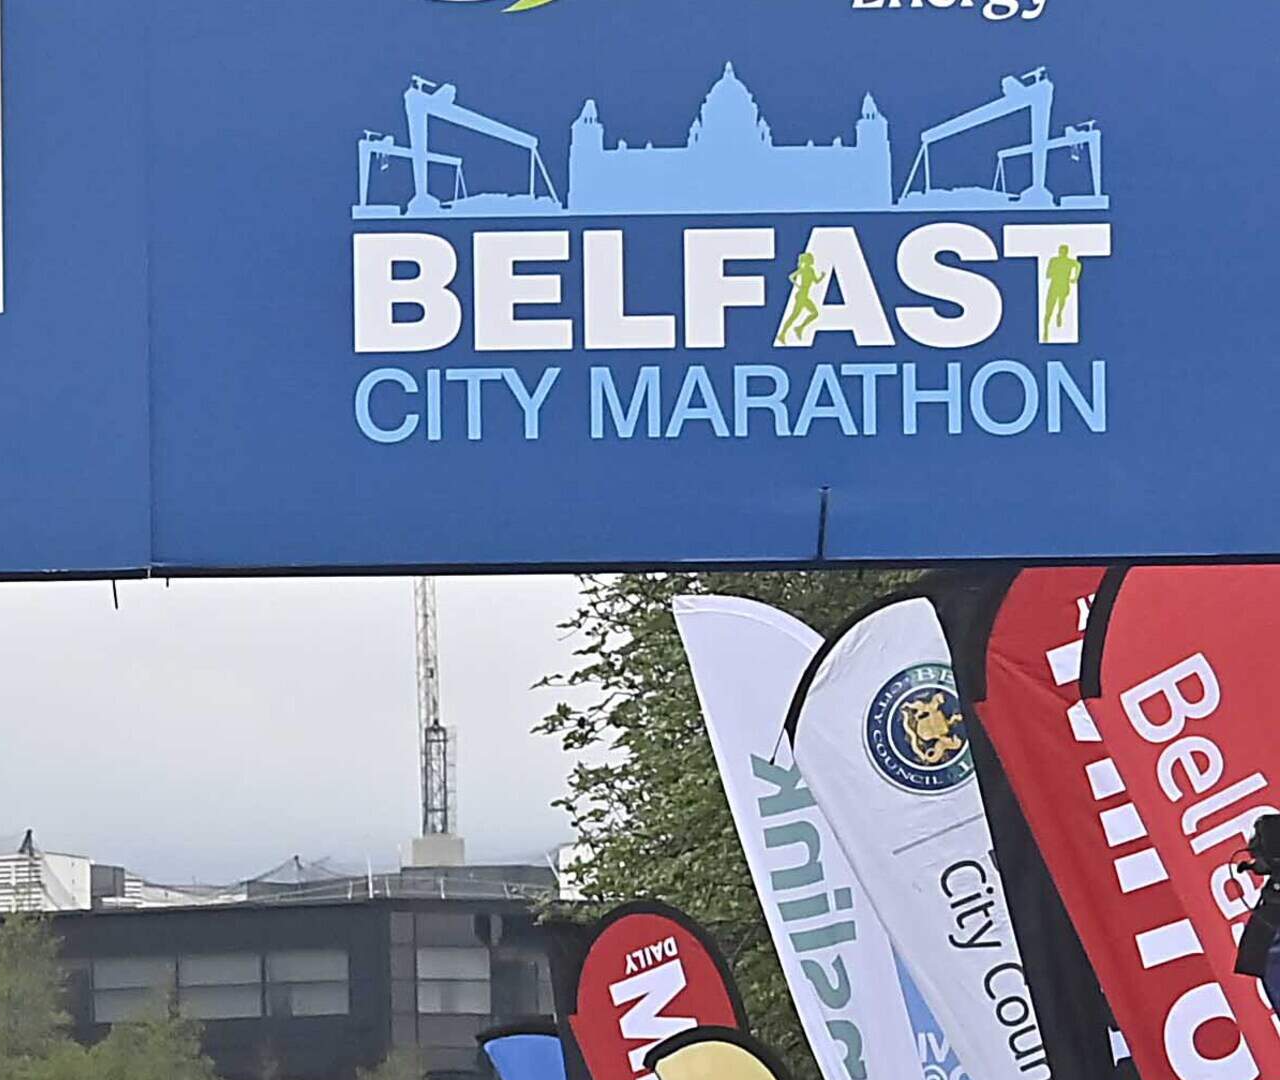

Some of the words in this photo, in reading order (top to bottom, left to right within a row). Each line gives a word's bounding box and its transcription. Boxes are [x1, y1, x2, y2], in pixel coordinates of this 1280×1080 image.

[353, 223, 1112, 353] BELFAST
[355, 366, 561, 444] CITY
[590, 360, 1107, 440] MARATHON
[873, 730, 944, 786] COUNCIL
[940, 858, 1004, 953] City
[625, 936, 679, 975] DAILY
